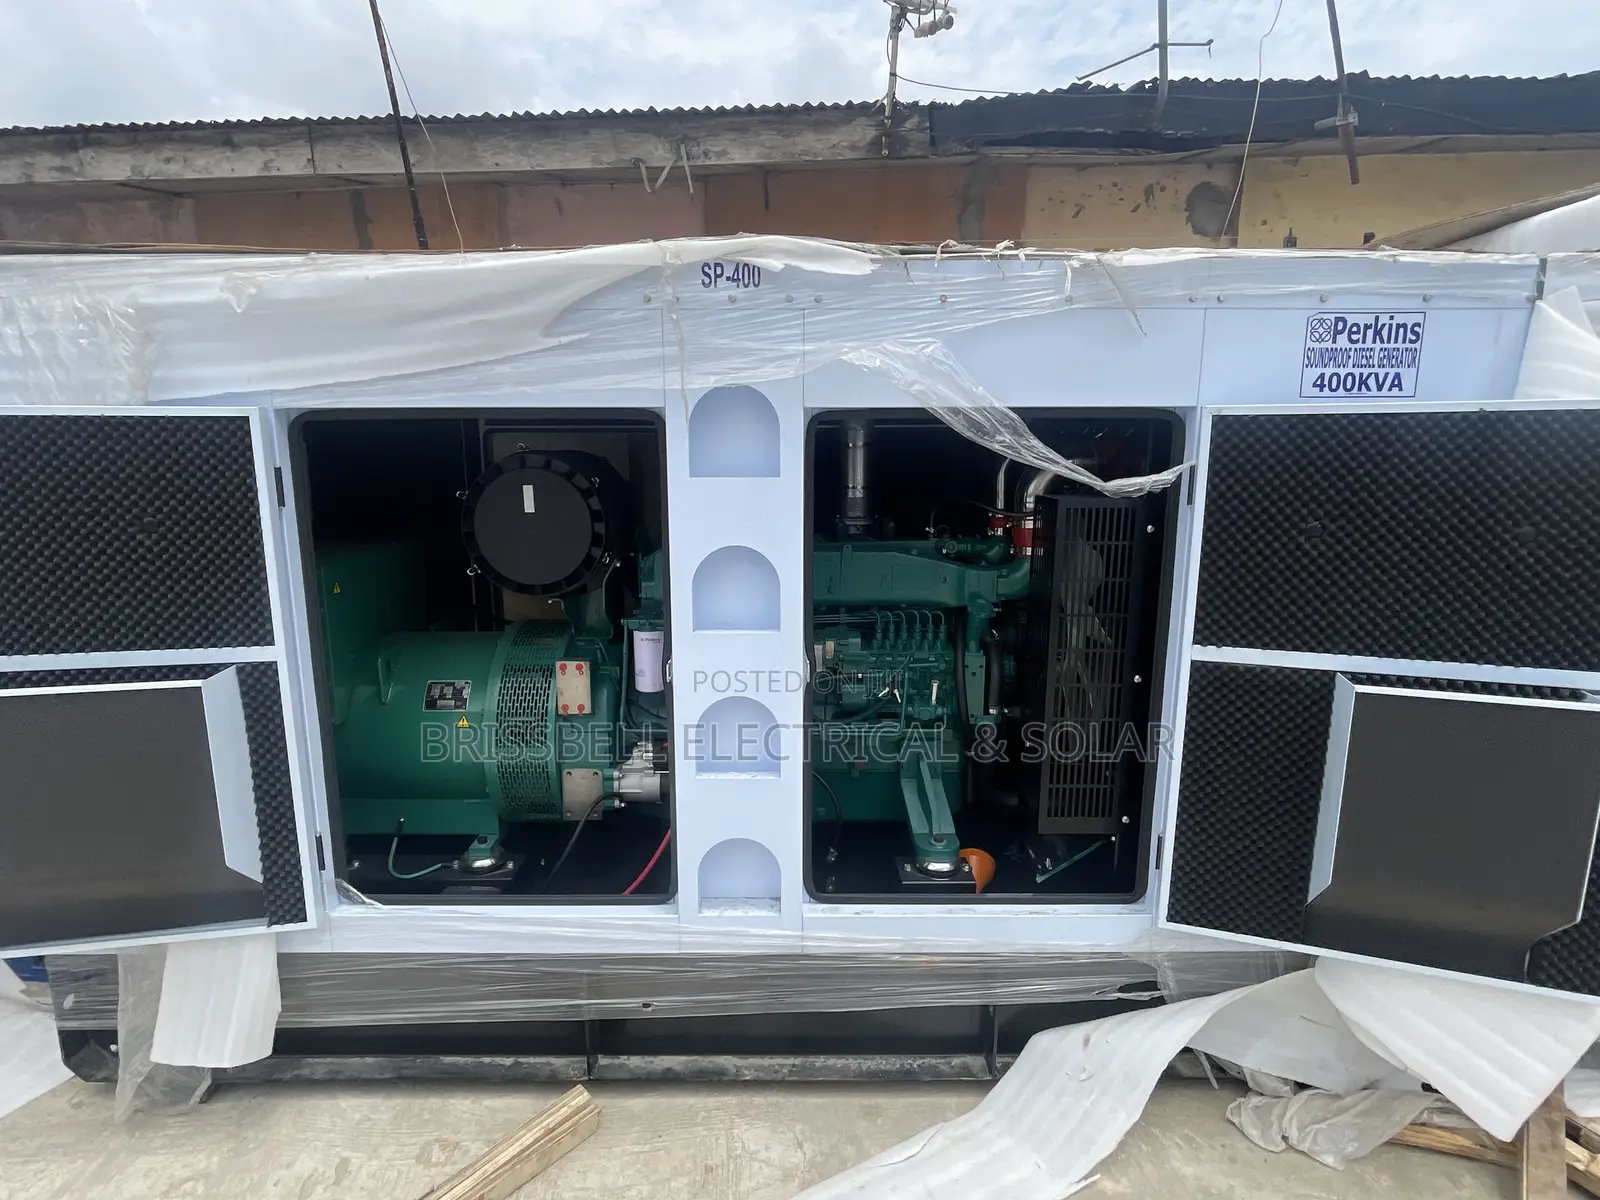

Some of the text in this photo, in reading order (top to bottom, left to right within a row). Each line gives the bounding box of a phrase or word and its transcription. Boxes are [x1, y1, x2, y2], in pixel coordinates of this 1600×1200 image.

[701, 262, 761, 288] SP-400
[1331, 315, 1422, 345] Perkins
[1305, 347, 1418, 368] SOUNDPROOF DIESEL GENERATOR
[1311, 371, 1404, 393] 400KVA
